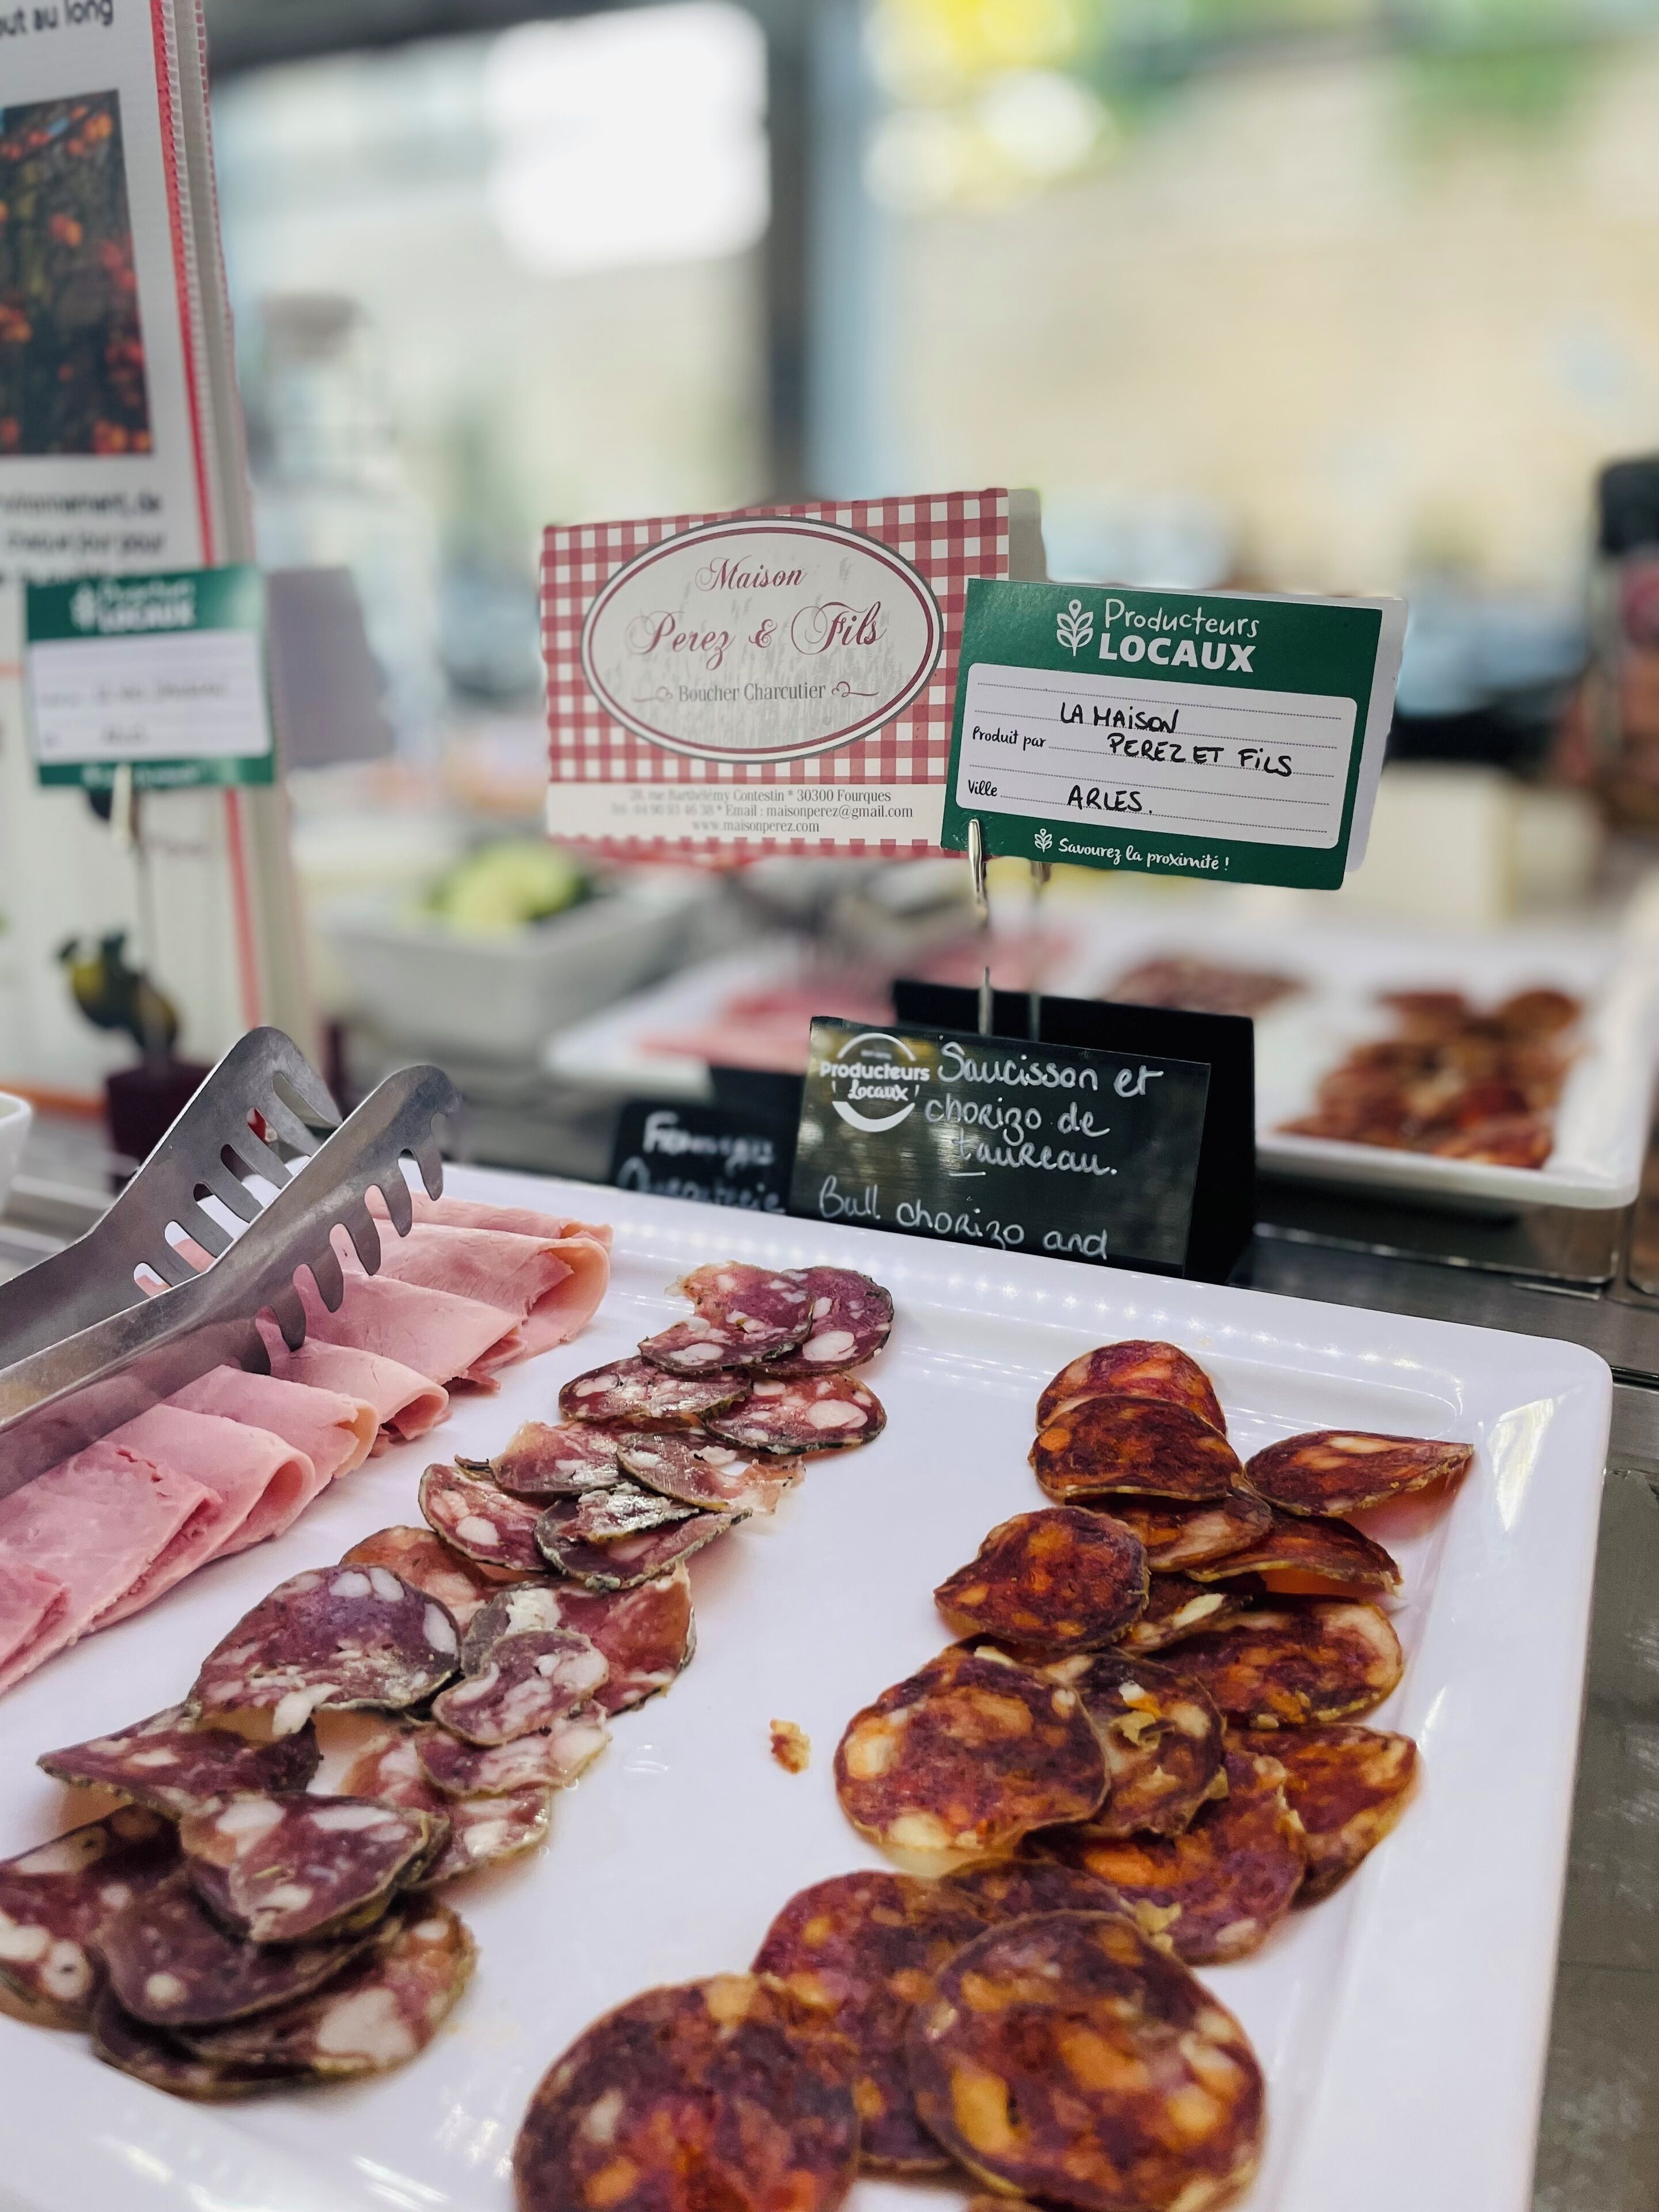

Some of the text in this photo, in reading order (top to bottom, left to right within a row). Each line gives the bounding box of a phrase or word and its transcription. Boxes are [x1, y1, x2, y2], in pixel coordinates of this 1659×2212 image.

[695, 555, 806, 592] Maison
[1105, 598, 1260, 639] Producteurs
[627, 601, 887, 671] Perez & Fils
[1099, 632, 1256, 673] LOCAUX
[679, 682, 826, 702] Boucher Charcutier
[1060, 702, 1084, 724] LA
[972, 726, 1047, 751] Produit par
[1107, 732, 1186, 763] PEREZ
[1192, 746, 1225, 765] ET
[733, 789, 784, 802] Contestin
[797, 789, 834, 802] 30300
[837, 789, 891, 804] Fourques
[968, 779, 998, 797] Ville
[725, 804, 757, 817] Email
[767, 804, 914, 820] maisonperez@gmail.com
[691, 821, 820, 834] www.maisonperez.com
[1058, 838, 1122, 865] Savourez
[1126, 844, 1143, 861] la
[1146, 853, 1219, 870] proximité
[819, 1061, 930, 1081] Producteurs
[937, 1041, 1164, 1097] Saucisson et
[848, 1078, 909, 1101] Locaux
[925, 1093, 1111, 1146] chorizo de
[819, 1175, 881, 1218] Bull
[1043, 1229, 1108, 1260] and
